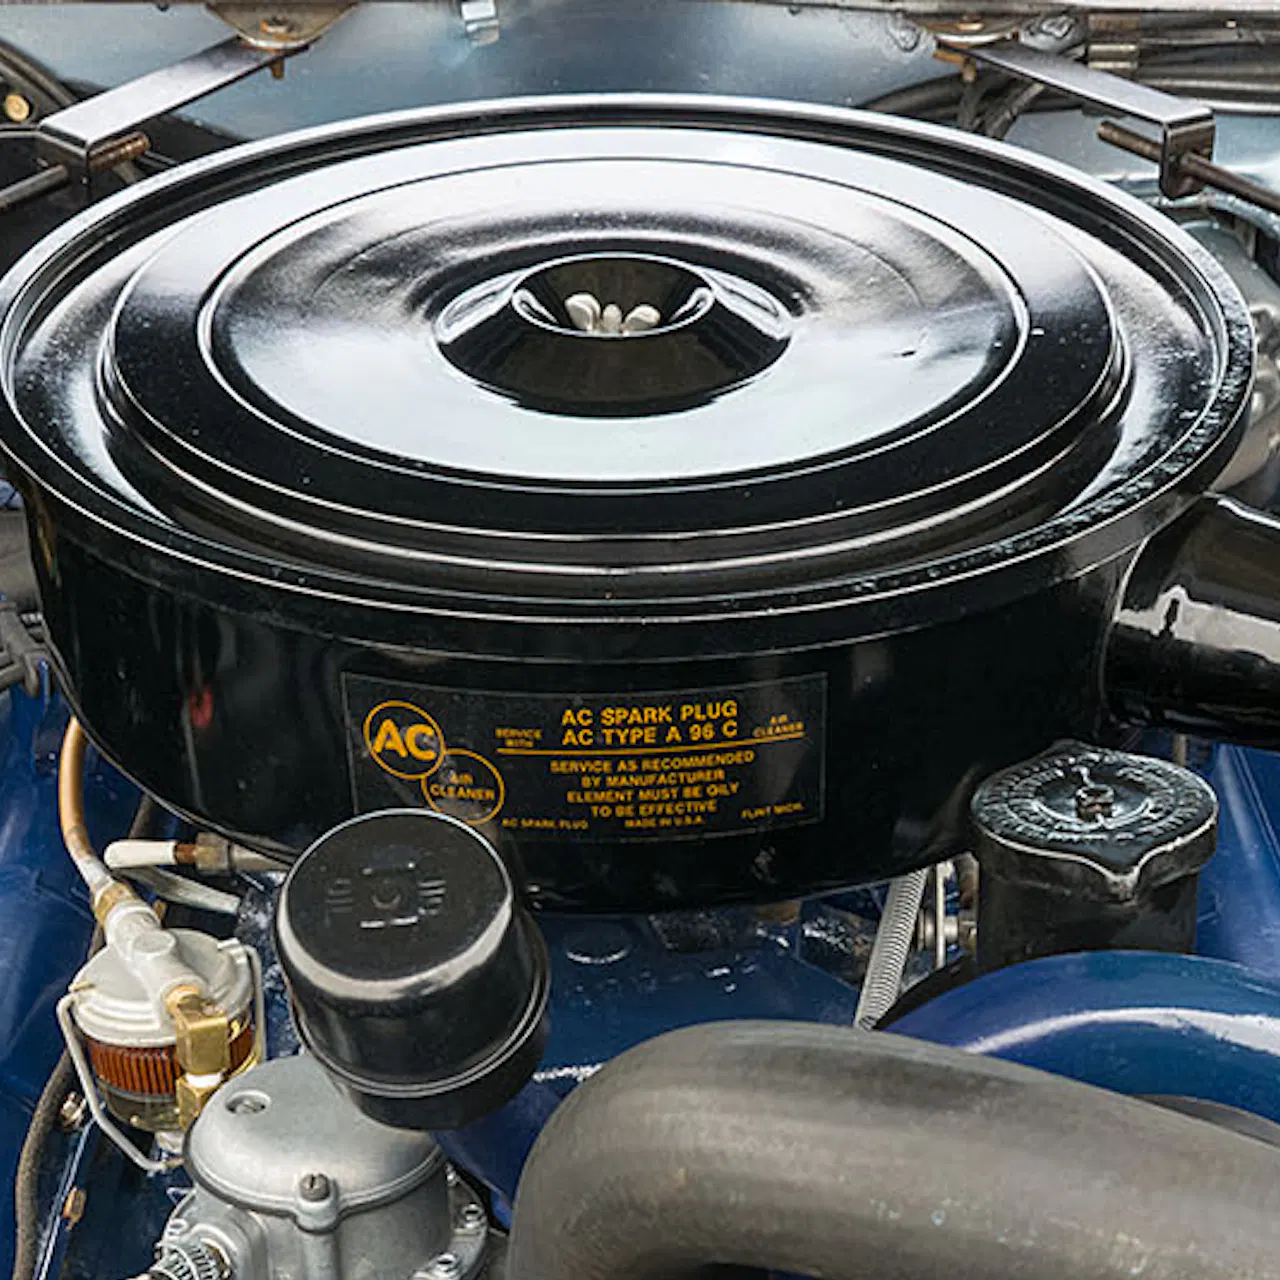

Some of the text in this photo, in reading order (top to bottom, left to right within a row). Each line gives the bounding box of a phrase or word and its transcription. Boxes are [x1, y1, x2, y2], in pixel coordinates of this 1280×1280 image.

[562, 700, 738, 726] AC SPARK PLUG
[372, 718, 437, 761] AC
[562, 720, 738, 746] AC TYPE A 96 C
[550, 750, 755, 774] SERVICE AS RECOMMENDED
[581, 768, 725, 788] BY MANUFACTURER
[430, 785, 495, 800] CLEANER
[566, 789, 633, 803] ELEMENT
[638, 787, 679, 801] MUST
[682, 785, 703, 799] BE
[591, 800, 718, 818] TO BE EFFECTIVE
